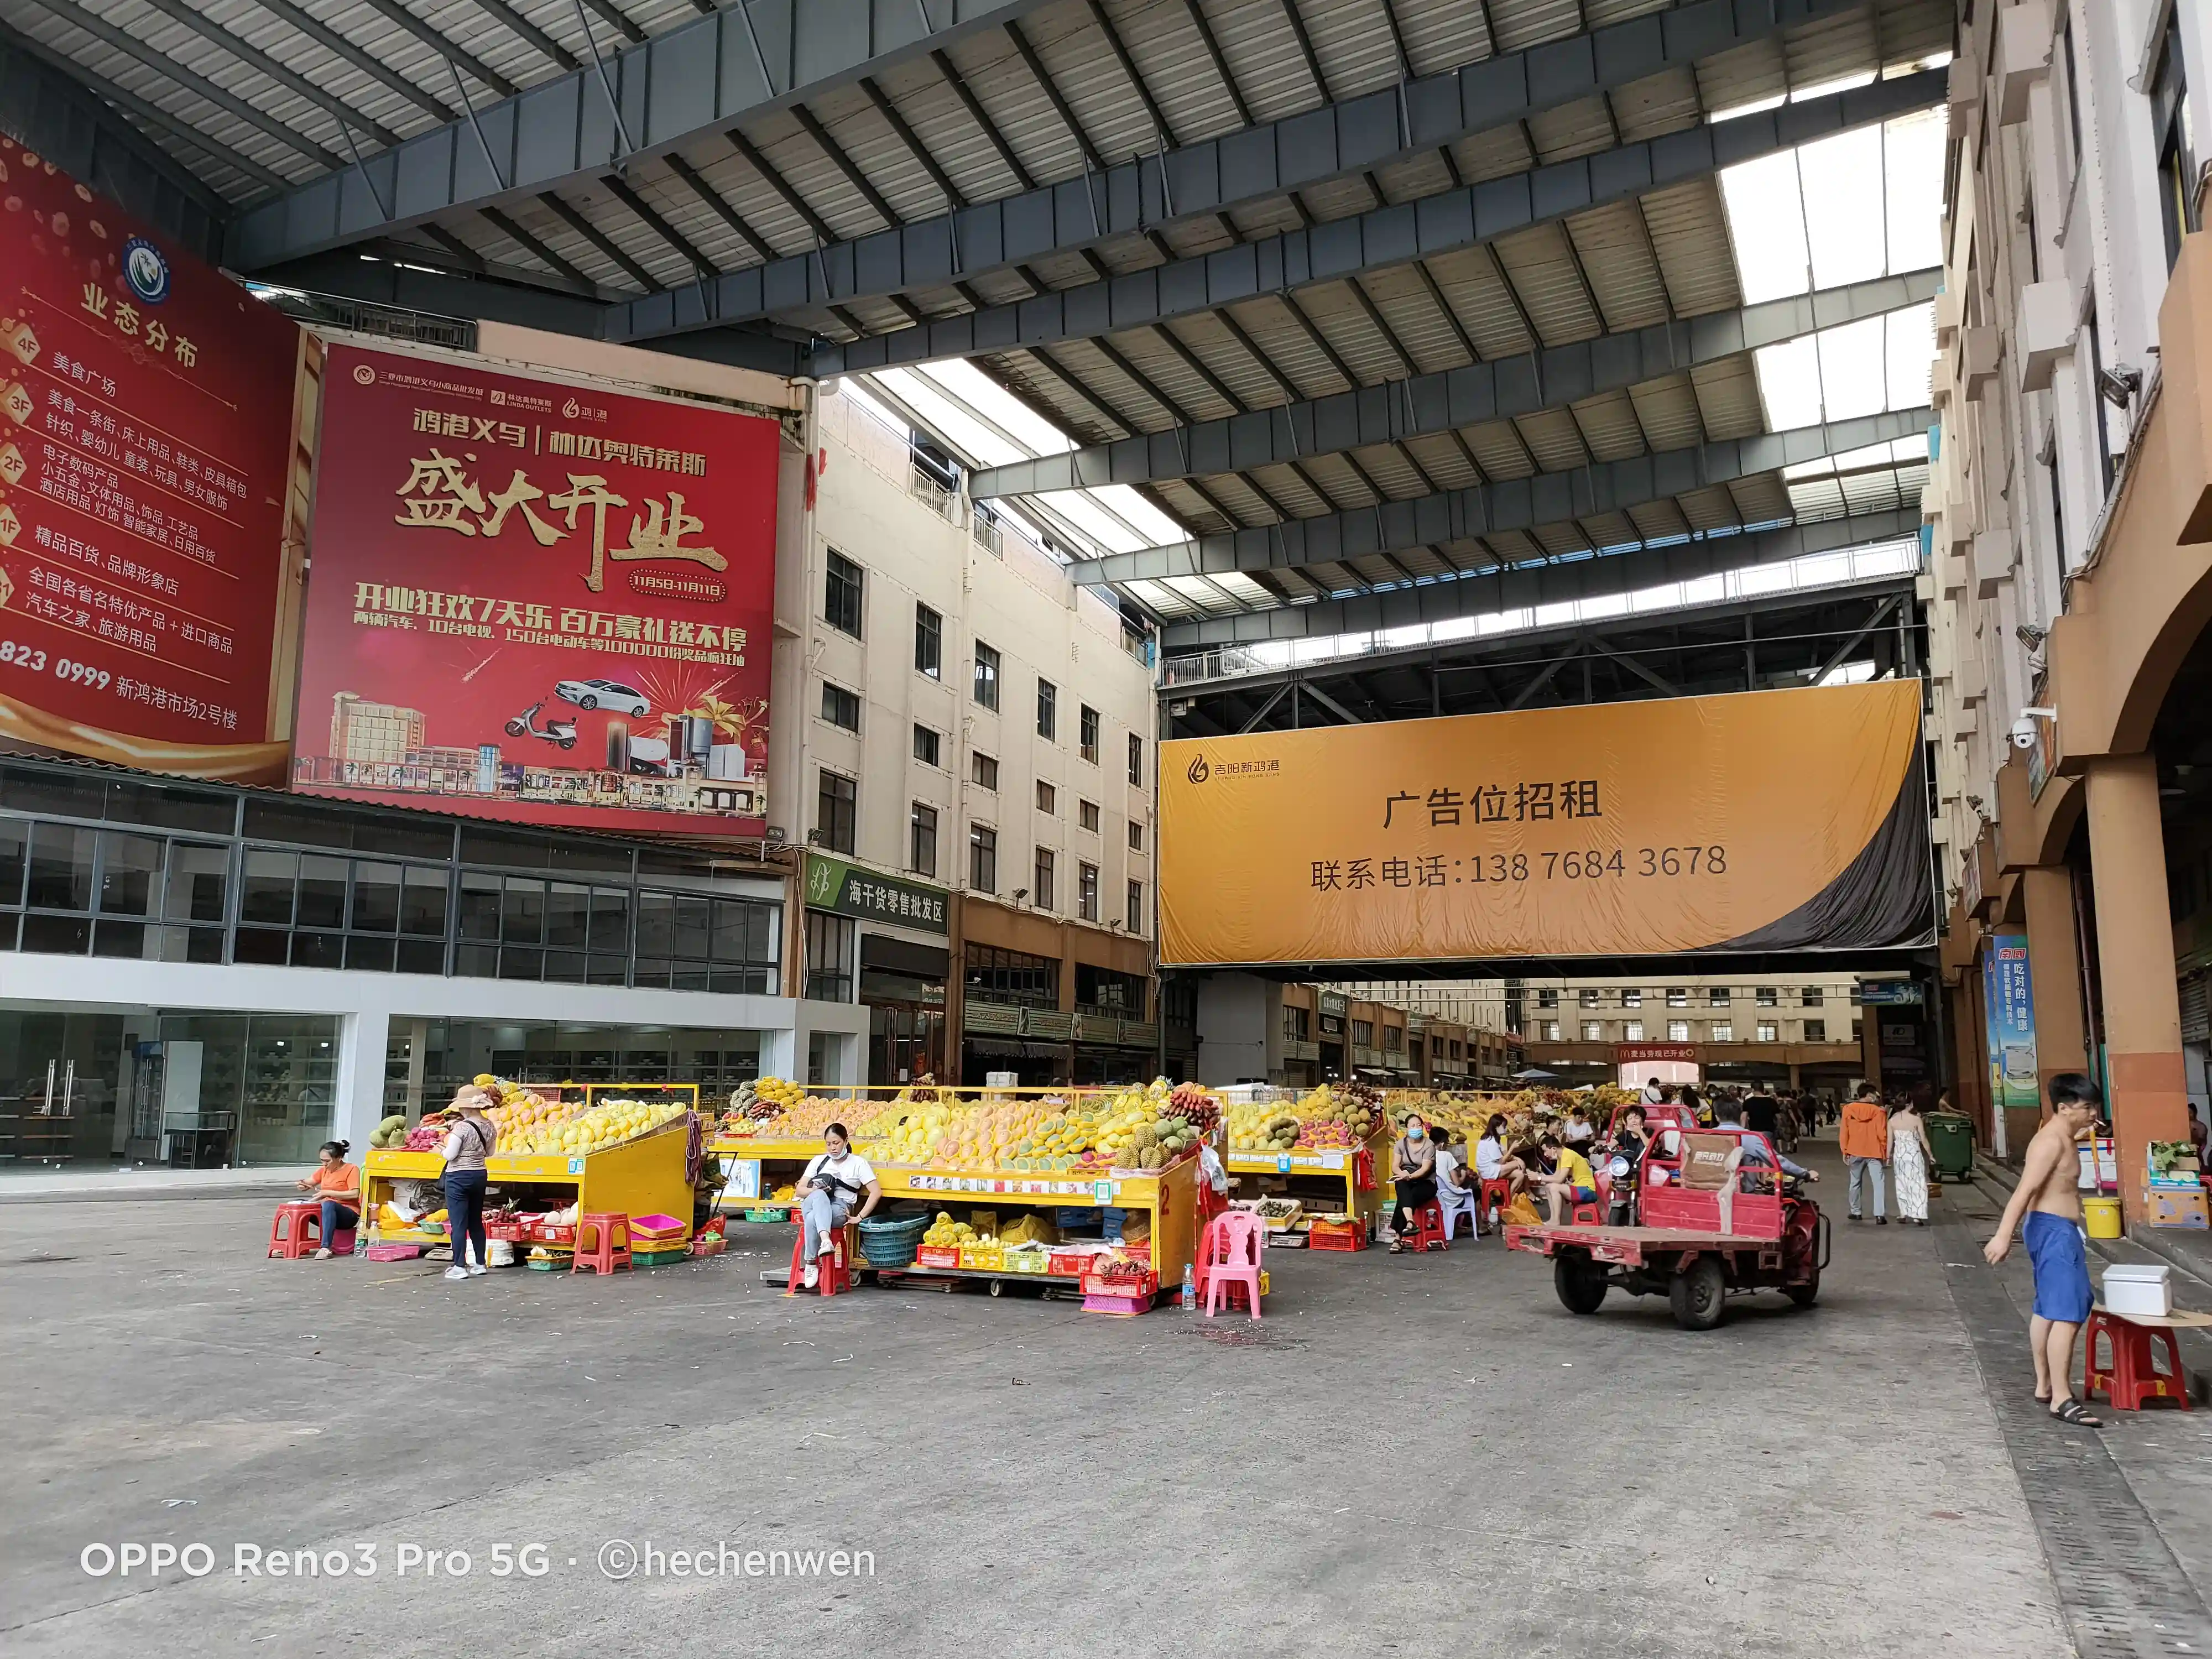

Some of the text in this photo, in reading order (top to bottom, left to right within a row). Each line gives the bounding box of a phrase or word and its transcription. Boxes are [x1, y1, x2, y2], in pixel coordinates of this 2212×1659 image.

[18, 337, 36, 353] 4F
[81, 282, 197, 368] 业态分布
[53, 352, 116, 397] 美食广场
[11, 396, 29, 413] 3F
[507, 401, 552, 413] LINDA OUTLETS
[508, 393, 552, 408] 林达奥特莱斯
[4, 456, 23, 472] 2F
[46, 412, 228, 512] 针织、婴幼儿 童装、玩具、男女服饰
[48, 389, 247, 498] 美食一条街、床上用品、鞋类、皮具箱包
[413, 408, 707, 477] 鸿港义乌 林达奥特莱斯
[44, 445, 118, 489] 电子数码产品
[39, 476, 216, 564] 酒店用品 灯饰 智能家居、日用百货
[41, 462, 198, 541] 小五金、文体用品、饰品 工艺品
[395, 448, 728, 592] 盛大开业
[1, 518, 17, 534] 1F
[35, 524, 179, 596] 精品百货、品牌形象店
[0, 582, 9, 597] 1
[633, 575, 721, 597] 11月5日-11月11日
[26, 591, 156, 653] 汽车之家、旅游用品
[29, 566, 165, 630] 全国各省名特优产品
[181, 622, 232, 655] 进口商品
[354, 582, 748, 652] 开业狂欢7天乐 百万豪礼送不停
[0, 640, 237, 731] 823 0999 新鸿港市场2号楼
[1214, 760, 1279, 775] 吉阳新鸿港
[1383, 780, 1603, 830] 广告位招租
[1541, 848, 1626, 881] 7684
[1638, 844, 1728, 877] 3678
[849, 878, 943, 923] 海干货零售批发区
